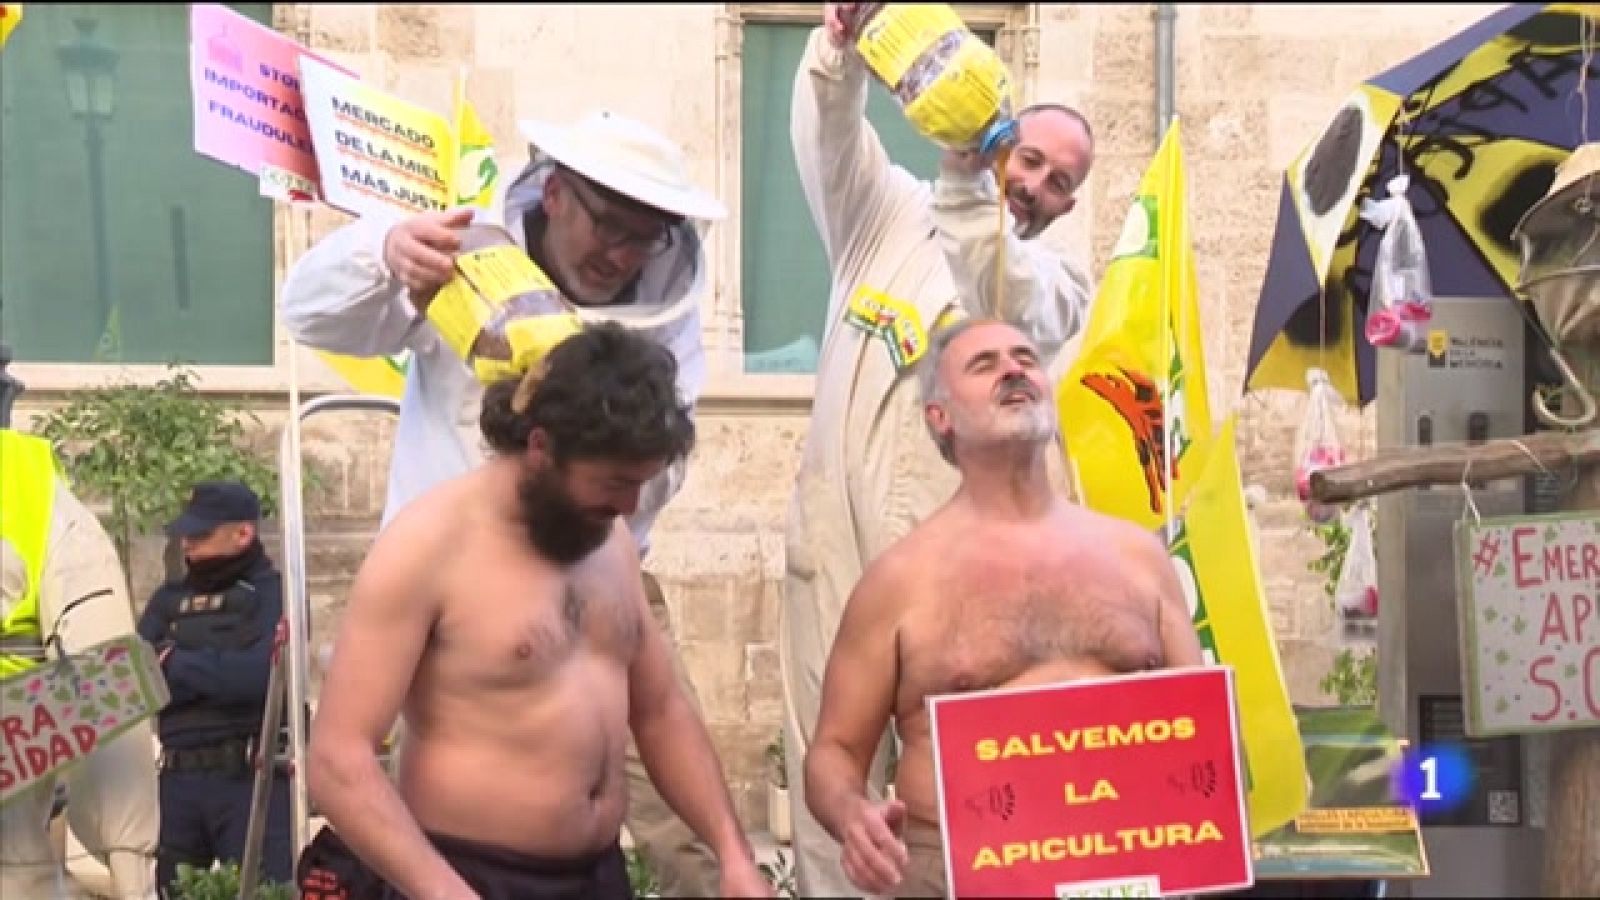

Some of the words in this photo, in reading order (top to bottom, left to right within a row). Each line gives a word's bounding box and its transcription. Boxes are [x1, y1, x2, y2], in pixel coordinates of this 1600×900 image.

[331, 95, 435, 149] MERCADO
[335, 130, 363, 151] DE
[367, 142, 395, 164] LA
[397, 154, 446, 186] MIEL
[974, 716, 1196, 761] SALVEMOS
[1064, 779, 1120, 805] LA
[972, 820, 1224, 871] APICULTURA
